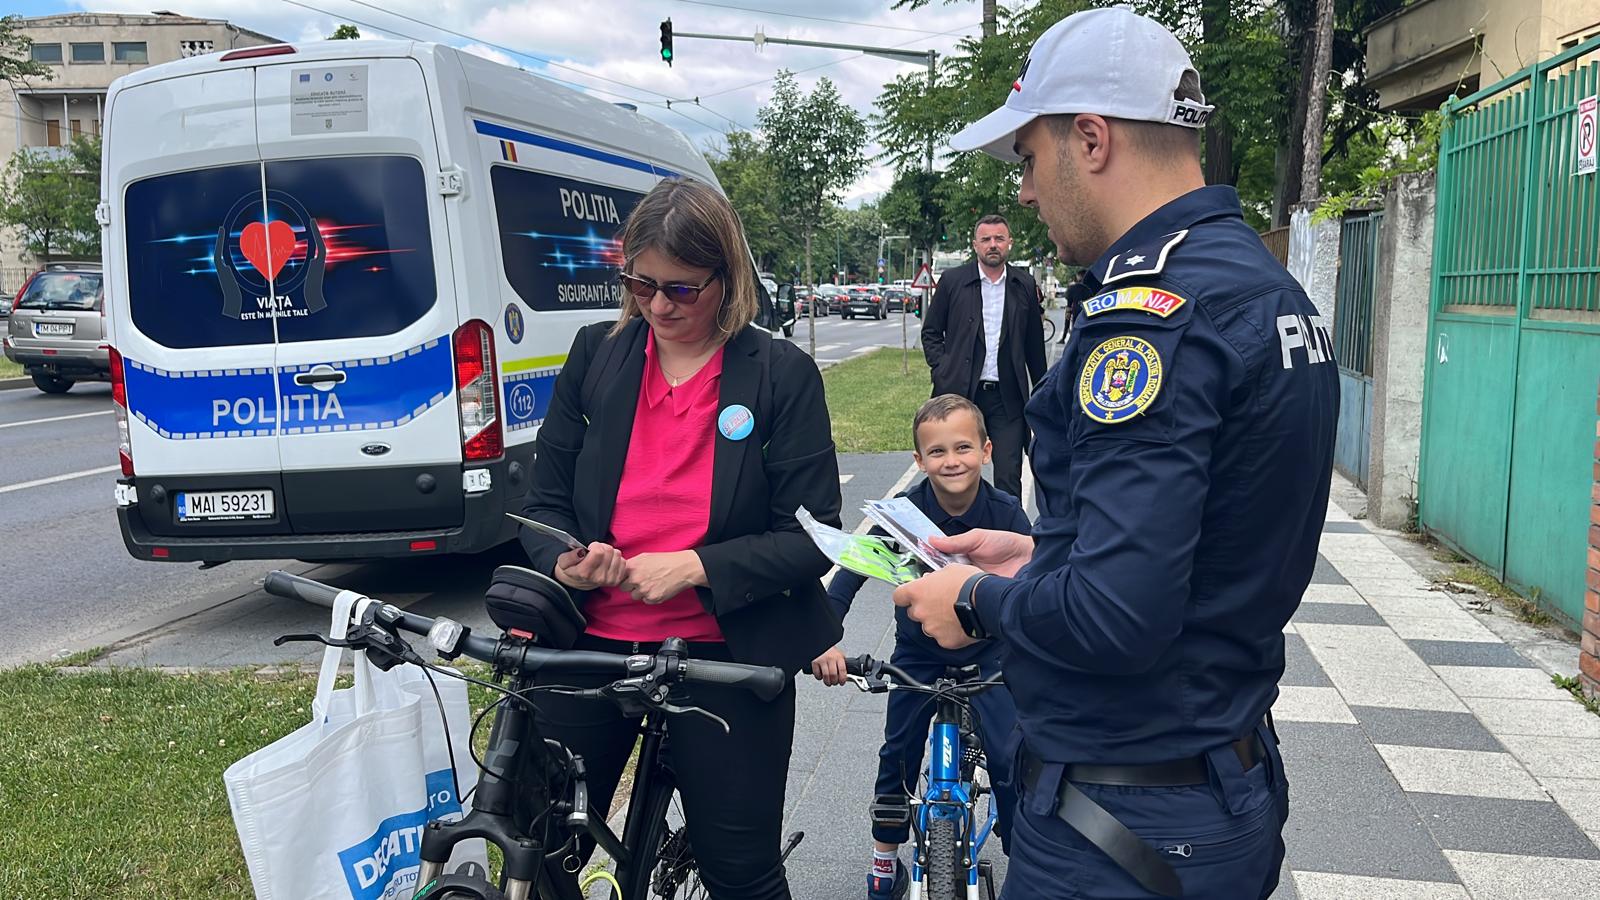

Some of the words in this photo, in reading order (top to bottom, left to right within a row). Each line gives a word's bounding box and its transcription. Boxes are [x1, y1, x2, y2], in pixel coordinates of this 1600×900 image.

[559, 188, 621, 225] POLITIA
[241, 312, 256, 320] ESTE
[292, 308, 308, 316] TALE
[1103, 339, 1134, 352] GENERAL
[1135, 342, 1144, 352] AL
[212, 392, 345, 426] POLITIA
[518, 394, 532, 412] 112
[192, 496, 215, 513] MAI
[221, 493, 266, 512] 59231
